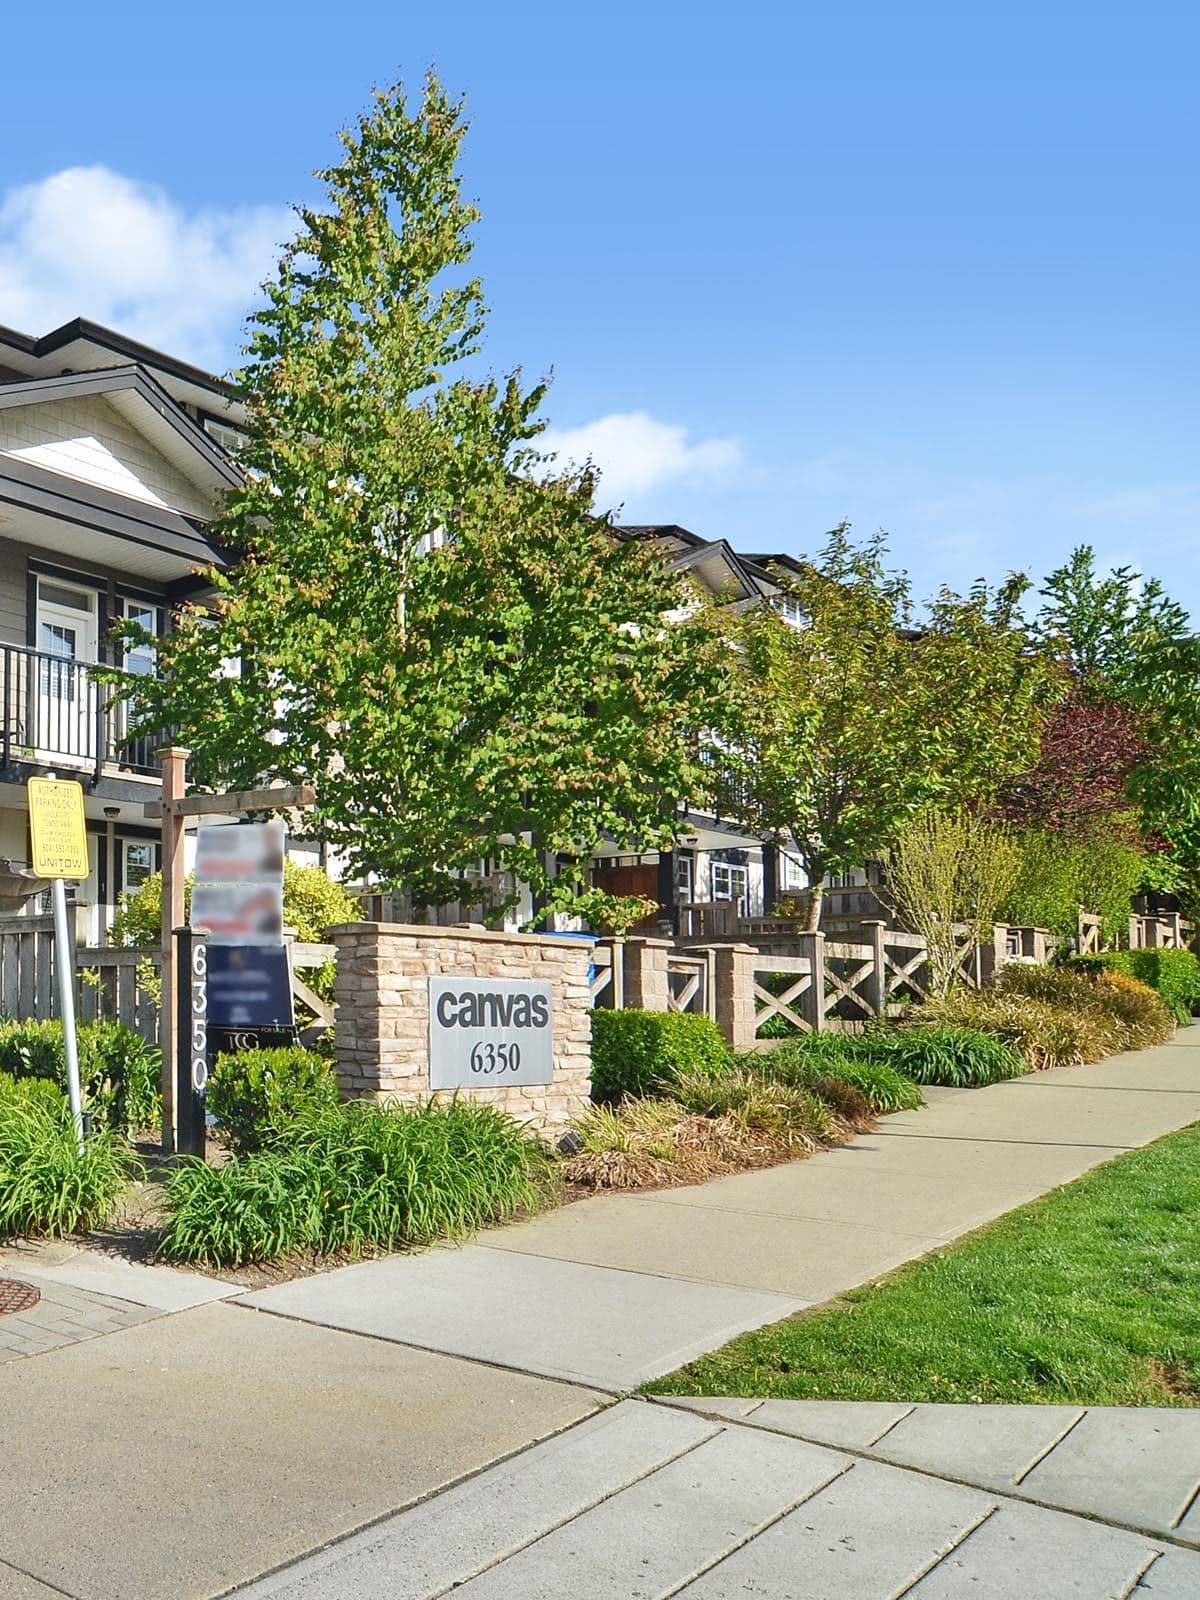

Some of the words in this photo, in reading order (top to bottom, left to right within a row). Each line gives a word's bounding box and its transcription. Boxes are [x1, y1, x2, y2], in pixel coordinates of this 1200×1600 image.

[40, 857, 82, 868] UNITOW
[192, 944, 208, 1090] 6350
[436, 991, 549, 1028] canvas
[470, 1041, 521, 1074] 6350
